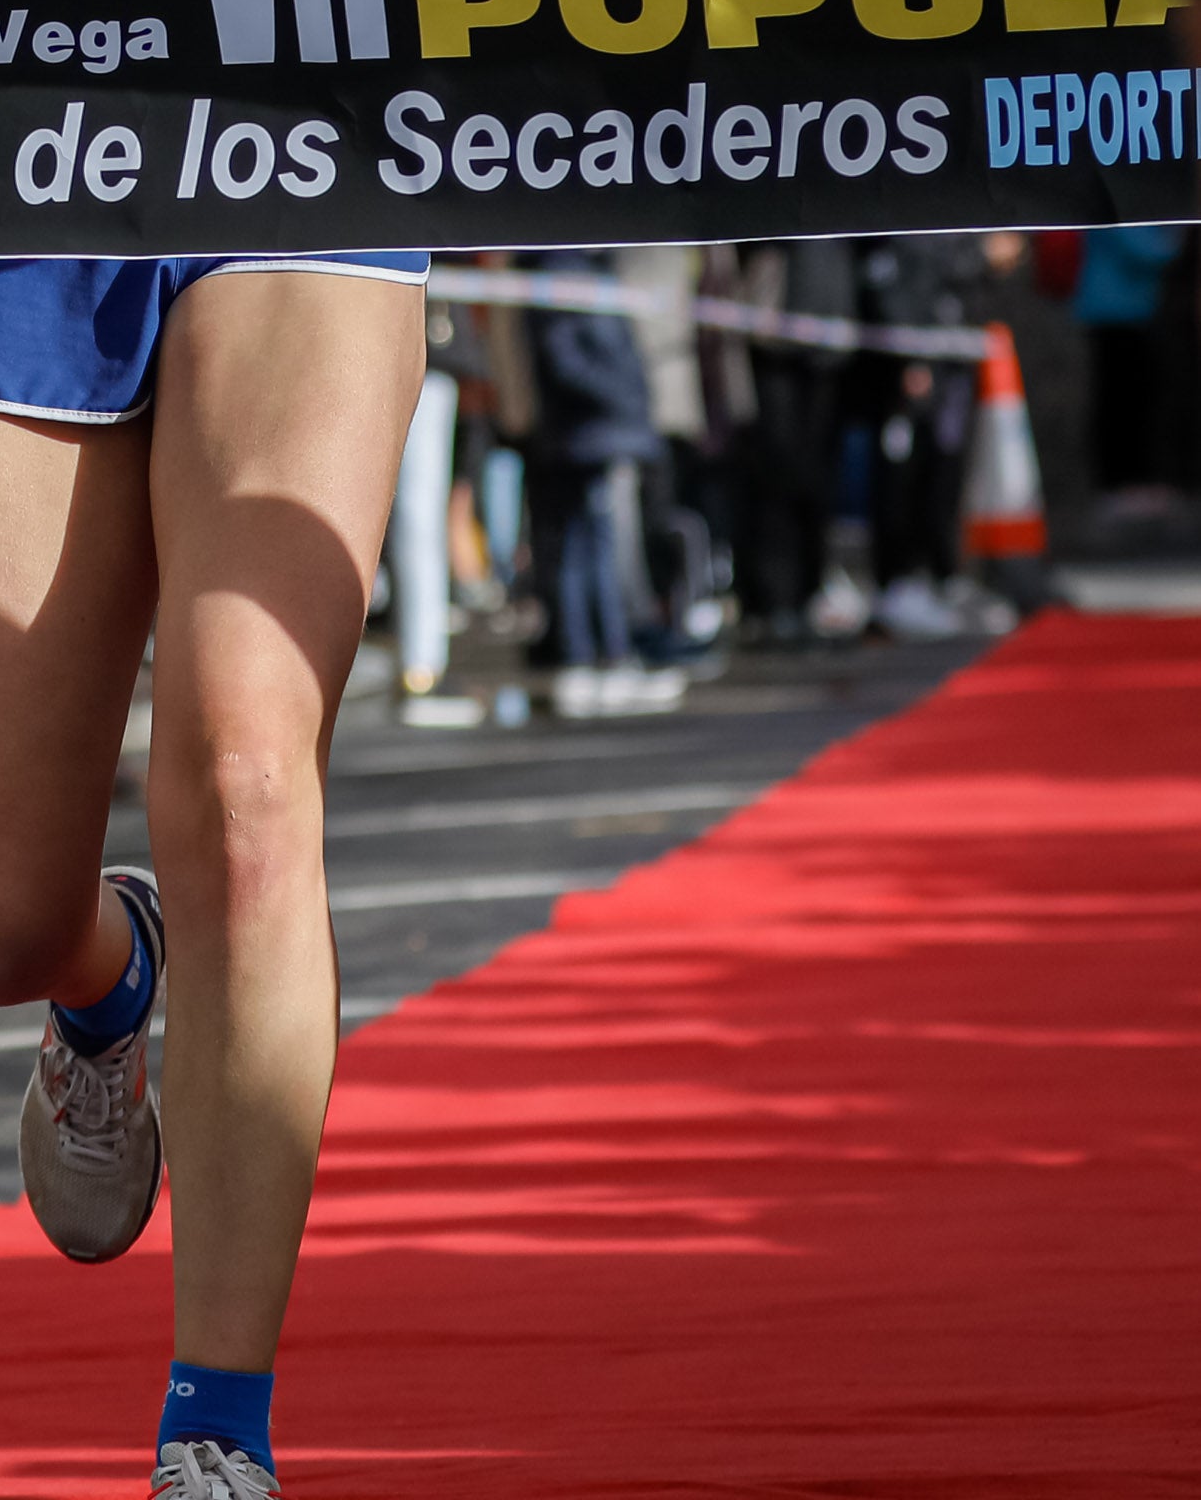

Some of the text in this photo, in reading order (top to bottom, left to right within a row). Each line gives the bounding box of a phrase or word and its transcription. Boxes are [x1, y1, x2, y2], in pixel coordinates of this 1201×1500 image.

[14, 101, 143, 205] de
[176, 98, 339, 200] los
[377, 82, 950, 195] Secaderos
[985, 68, 1201, 168] DEPORT
